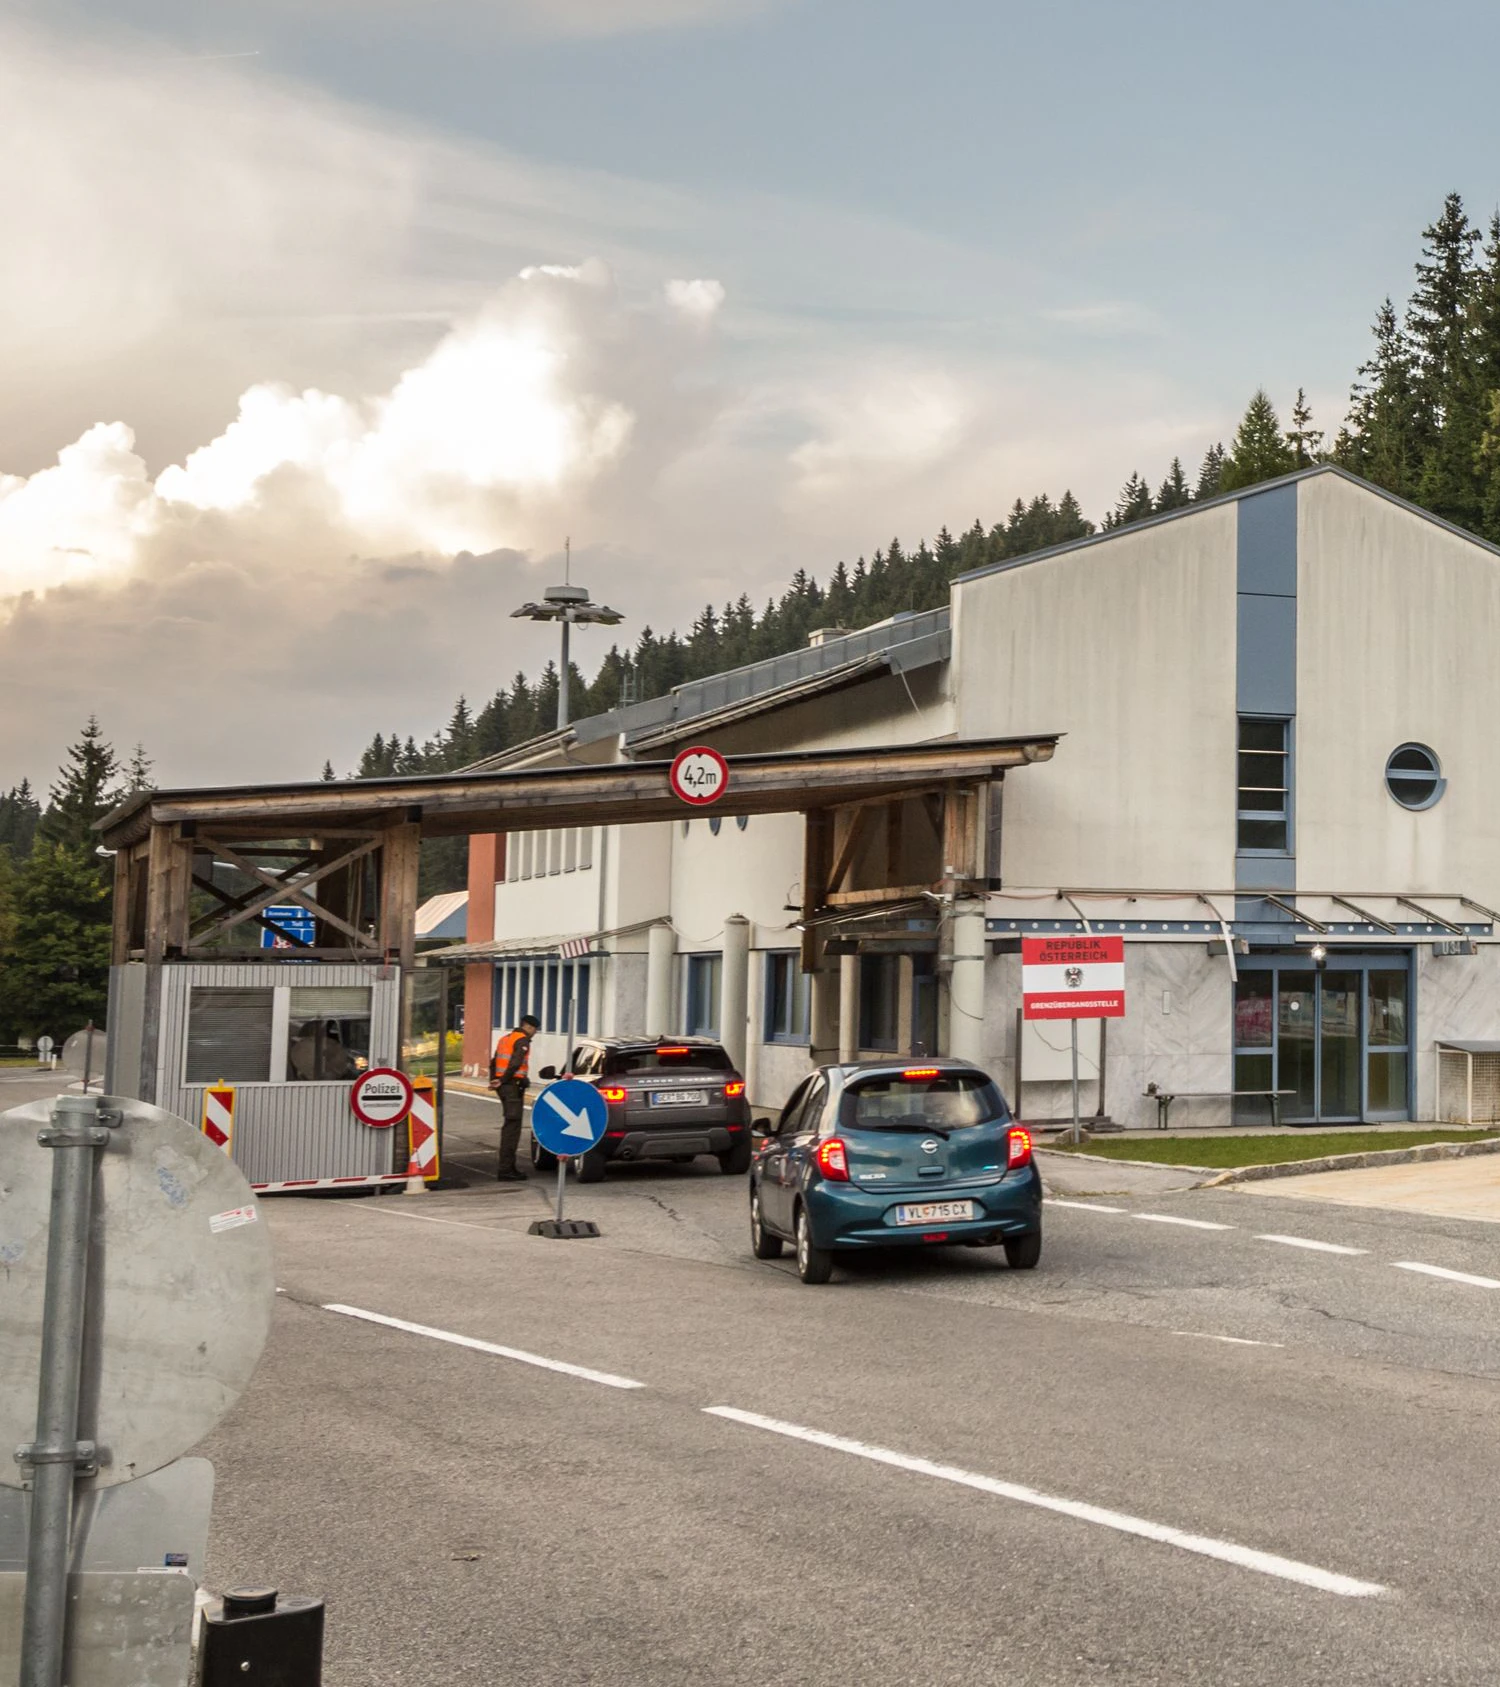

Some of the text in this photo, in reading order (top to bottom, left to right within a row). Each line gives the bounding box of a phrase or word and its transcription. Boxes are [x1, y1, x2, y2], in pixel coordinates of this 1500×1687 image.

[684, 765, 717, 788] 4,2m
[1046, 940, 1101, 950] REPUBLIK
[1039, 950, 1108, 962] ÖSTERREICH
[365, 1083, 400, 1093] Polizei
[908, 1204, 967, 1219] VL 715 CX
